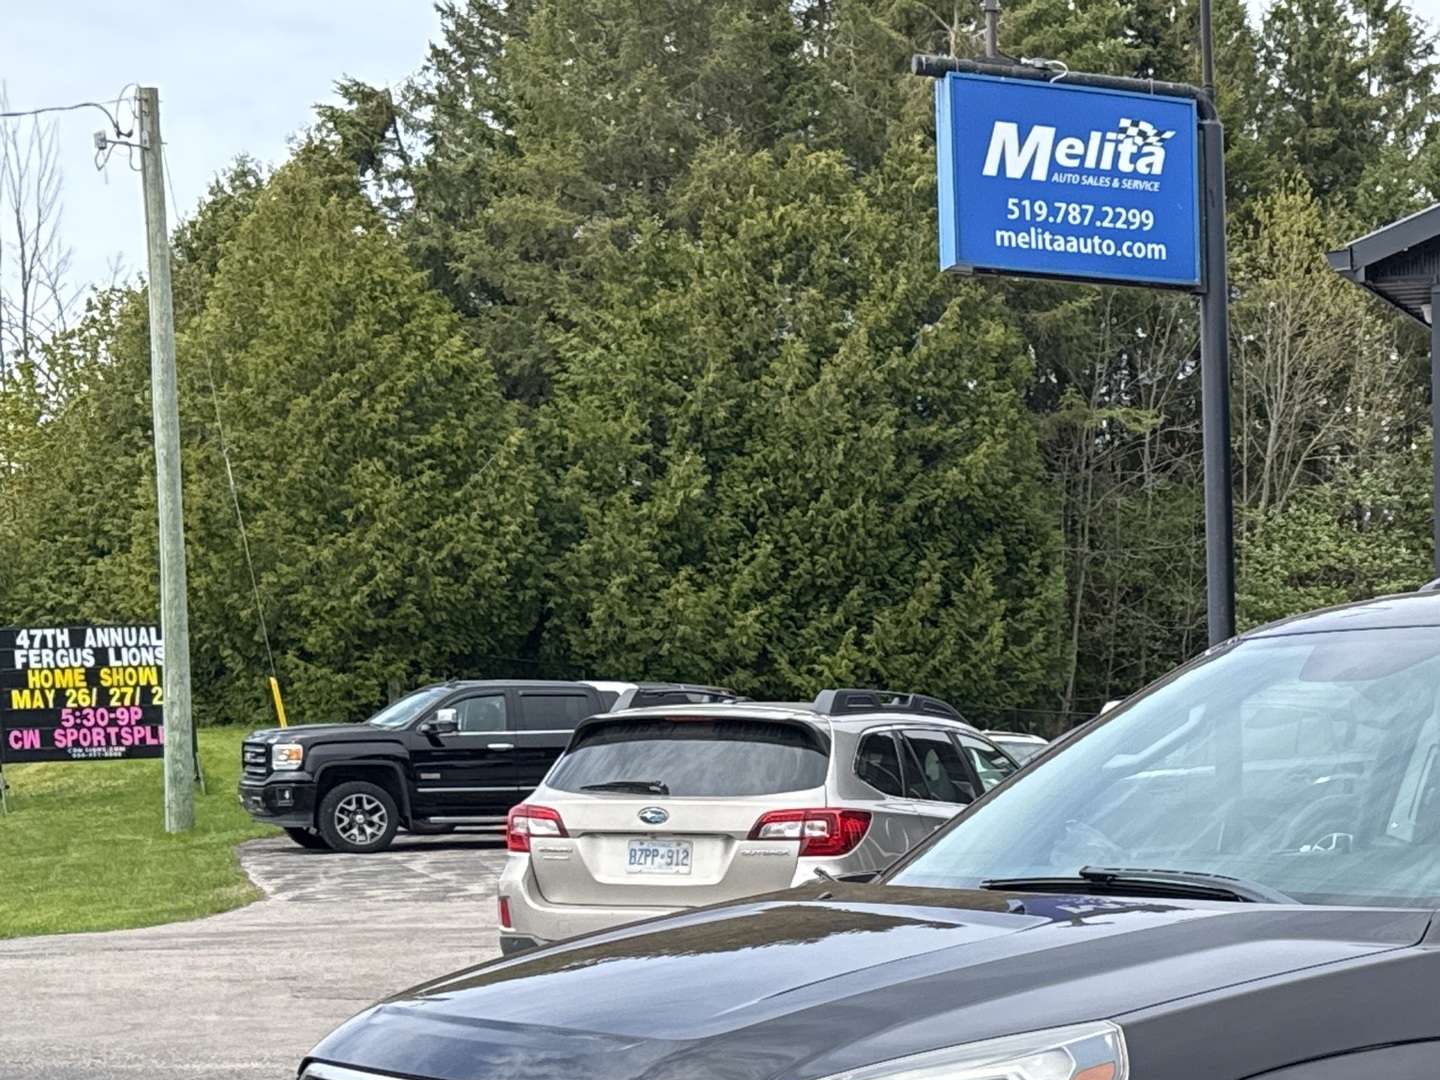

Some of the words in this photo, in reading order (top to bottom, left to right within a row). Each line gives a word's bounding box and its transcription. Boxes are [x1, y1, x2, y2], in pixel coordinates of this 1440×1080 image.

[982, 120, 1167, 182] Melita
[1051, 172, 1080, 184] AUTO
[1081, 174, 1111, 188] SALES
[1112, 178, 1120, 188] &
[1121, 178, 1161, 192] SERVICE
[1007, 198, 1154, 231] 519.787.2299
[995, 227, 1167, 260] melitaauto.com
[15, 628, 70, 649] 47TH
[84, 627, 163, 648] ANNUAL
[14, 648, 96, 669] FERGUS
[108, 647, 165, 667] LIONS
[27, 668, 88, 689] HOME
[100, 667, 158, 687] SHOW
[11, 689, 55, 709] MAY
[61, 706, 143, 727] 5:30-9P
[8, 729, 41, 749] CW
[628, 848, 660, 867] BZPP
[665, 848, 690, 867] 912
